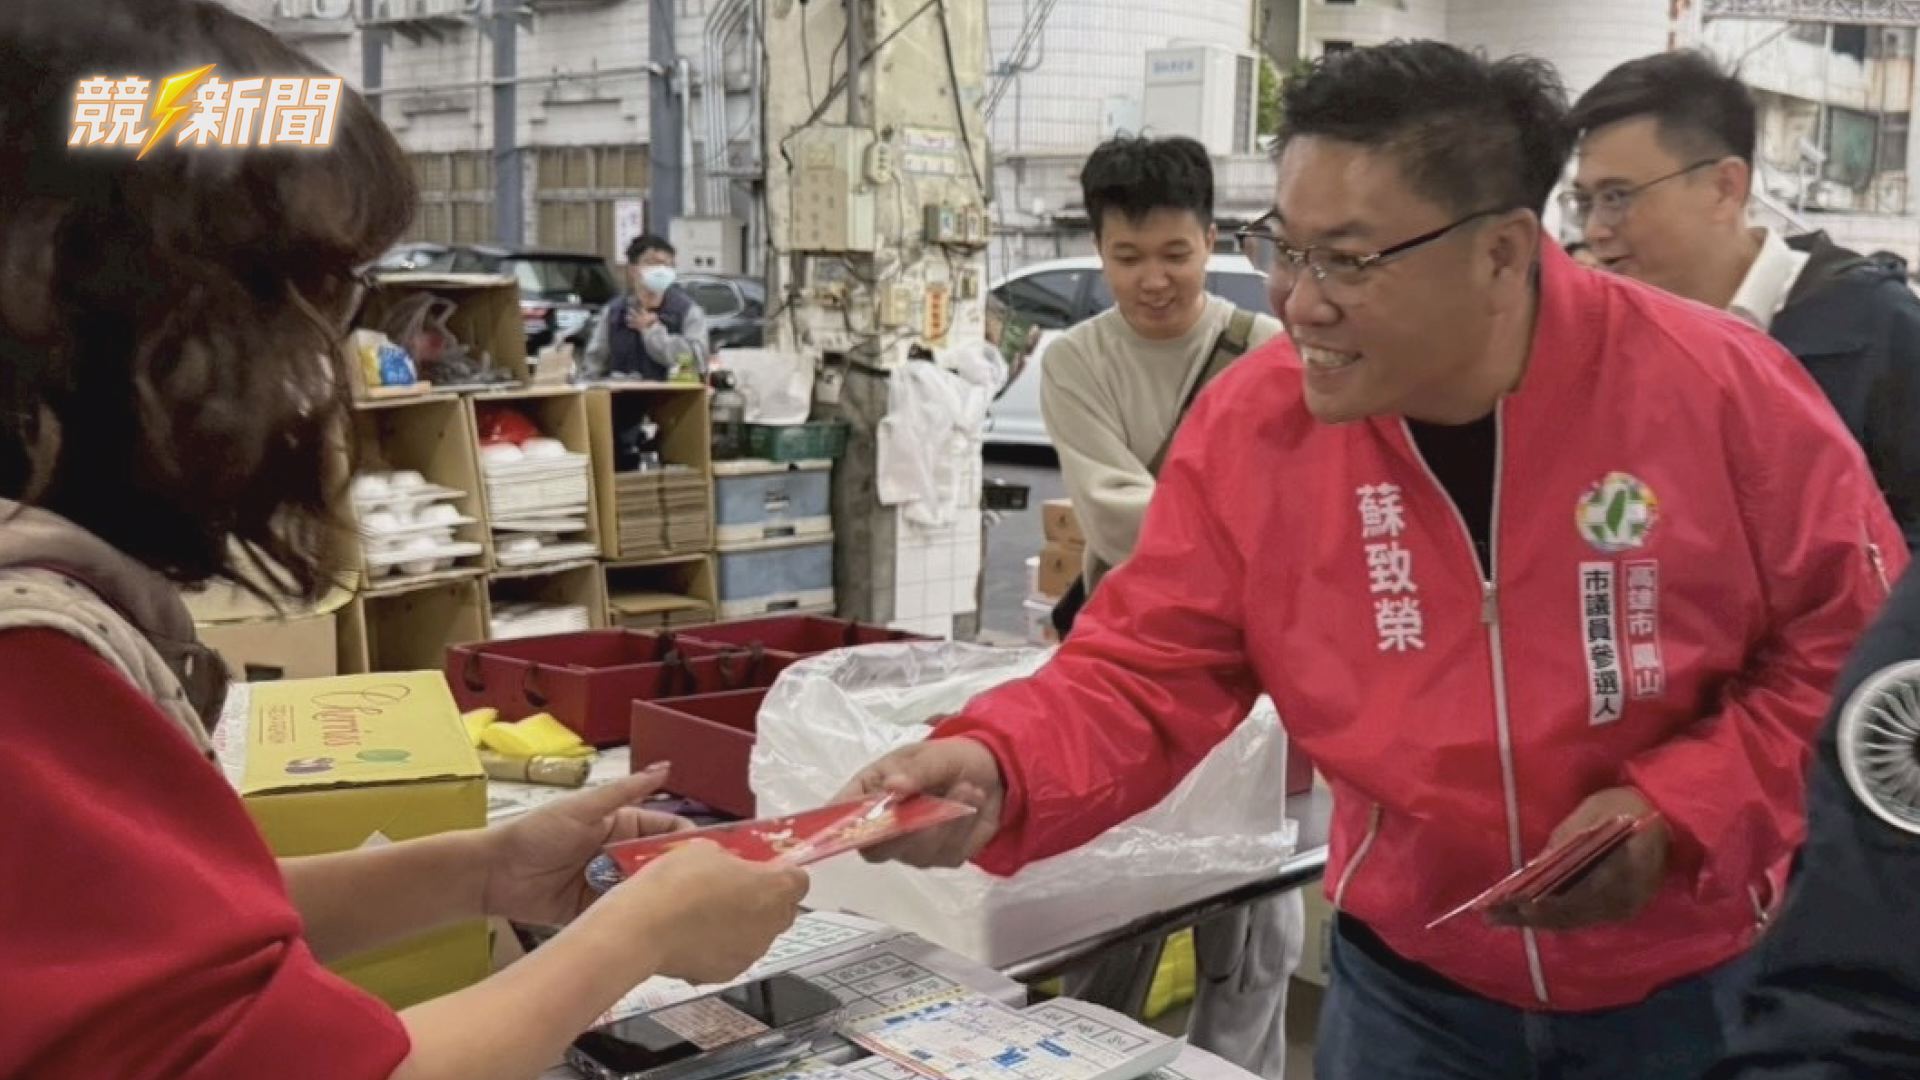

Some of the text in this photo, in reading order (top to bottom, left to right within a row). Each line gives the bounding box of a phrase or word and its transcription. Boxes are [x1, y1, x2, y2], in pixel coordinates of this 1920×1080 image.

[1355, 482, 1426, 652] 蘇致榮
[1583, 568, 1618, 720] 市議員參選人
